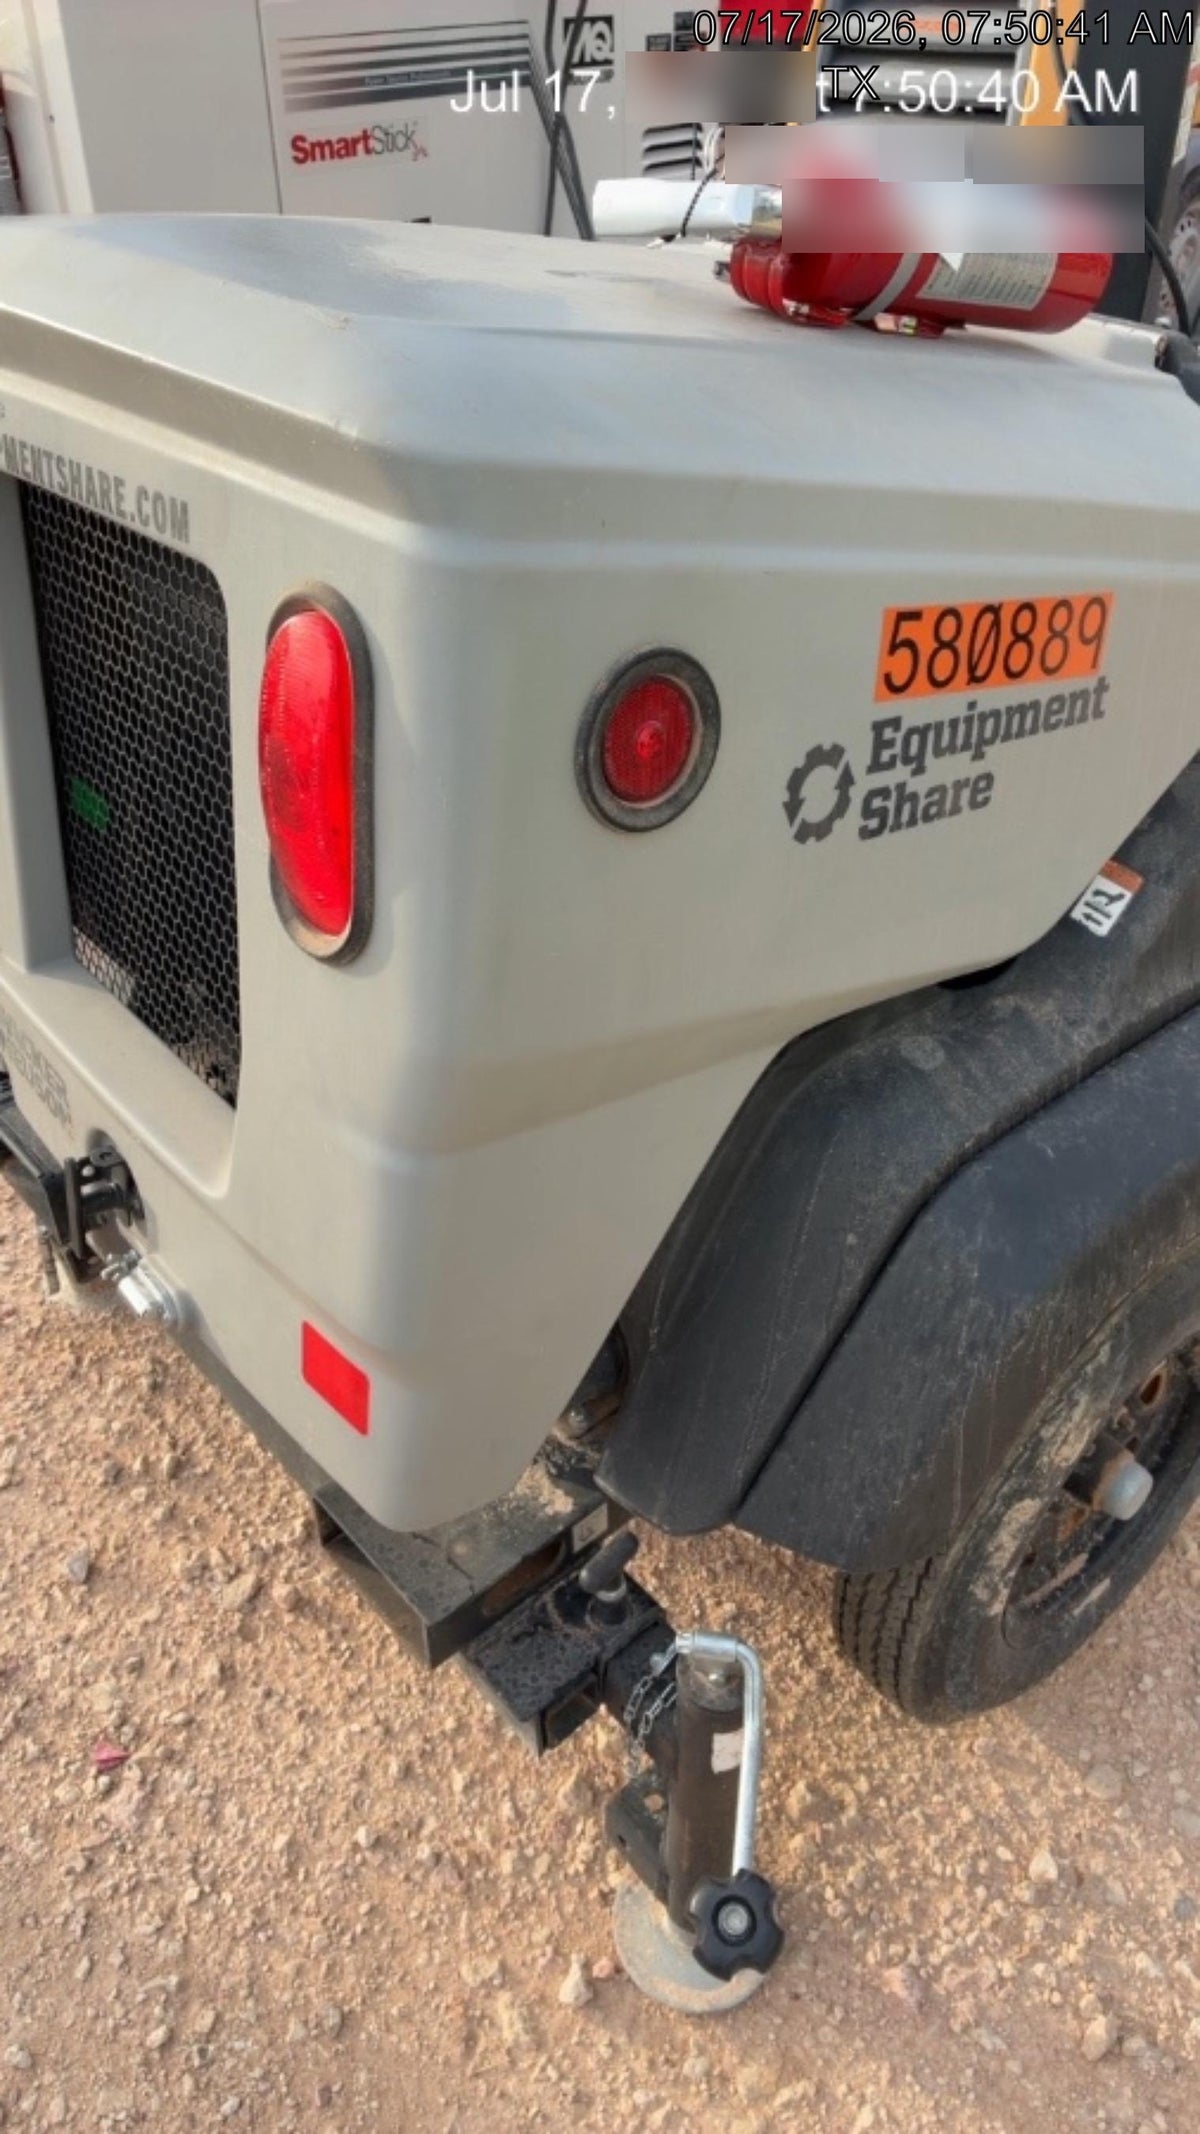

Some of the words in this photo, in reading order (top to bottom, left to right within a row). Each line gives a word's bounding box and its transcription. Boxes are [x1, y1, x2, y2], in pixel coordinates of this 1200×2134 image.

[291, 123, 416, 165] SmartStick
[0, 432, 189, 544] MENTSHARE.COM
[883, 596, 1108, 695] 580889
[866, 676, 1110, 777] Equipment
[858, 771, 994, 841] Share
